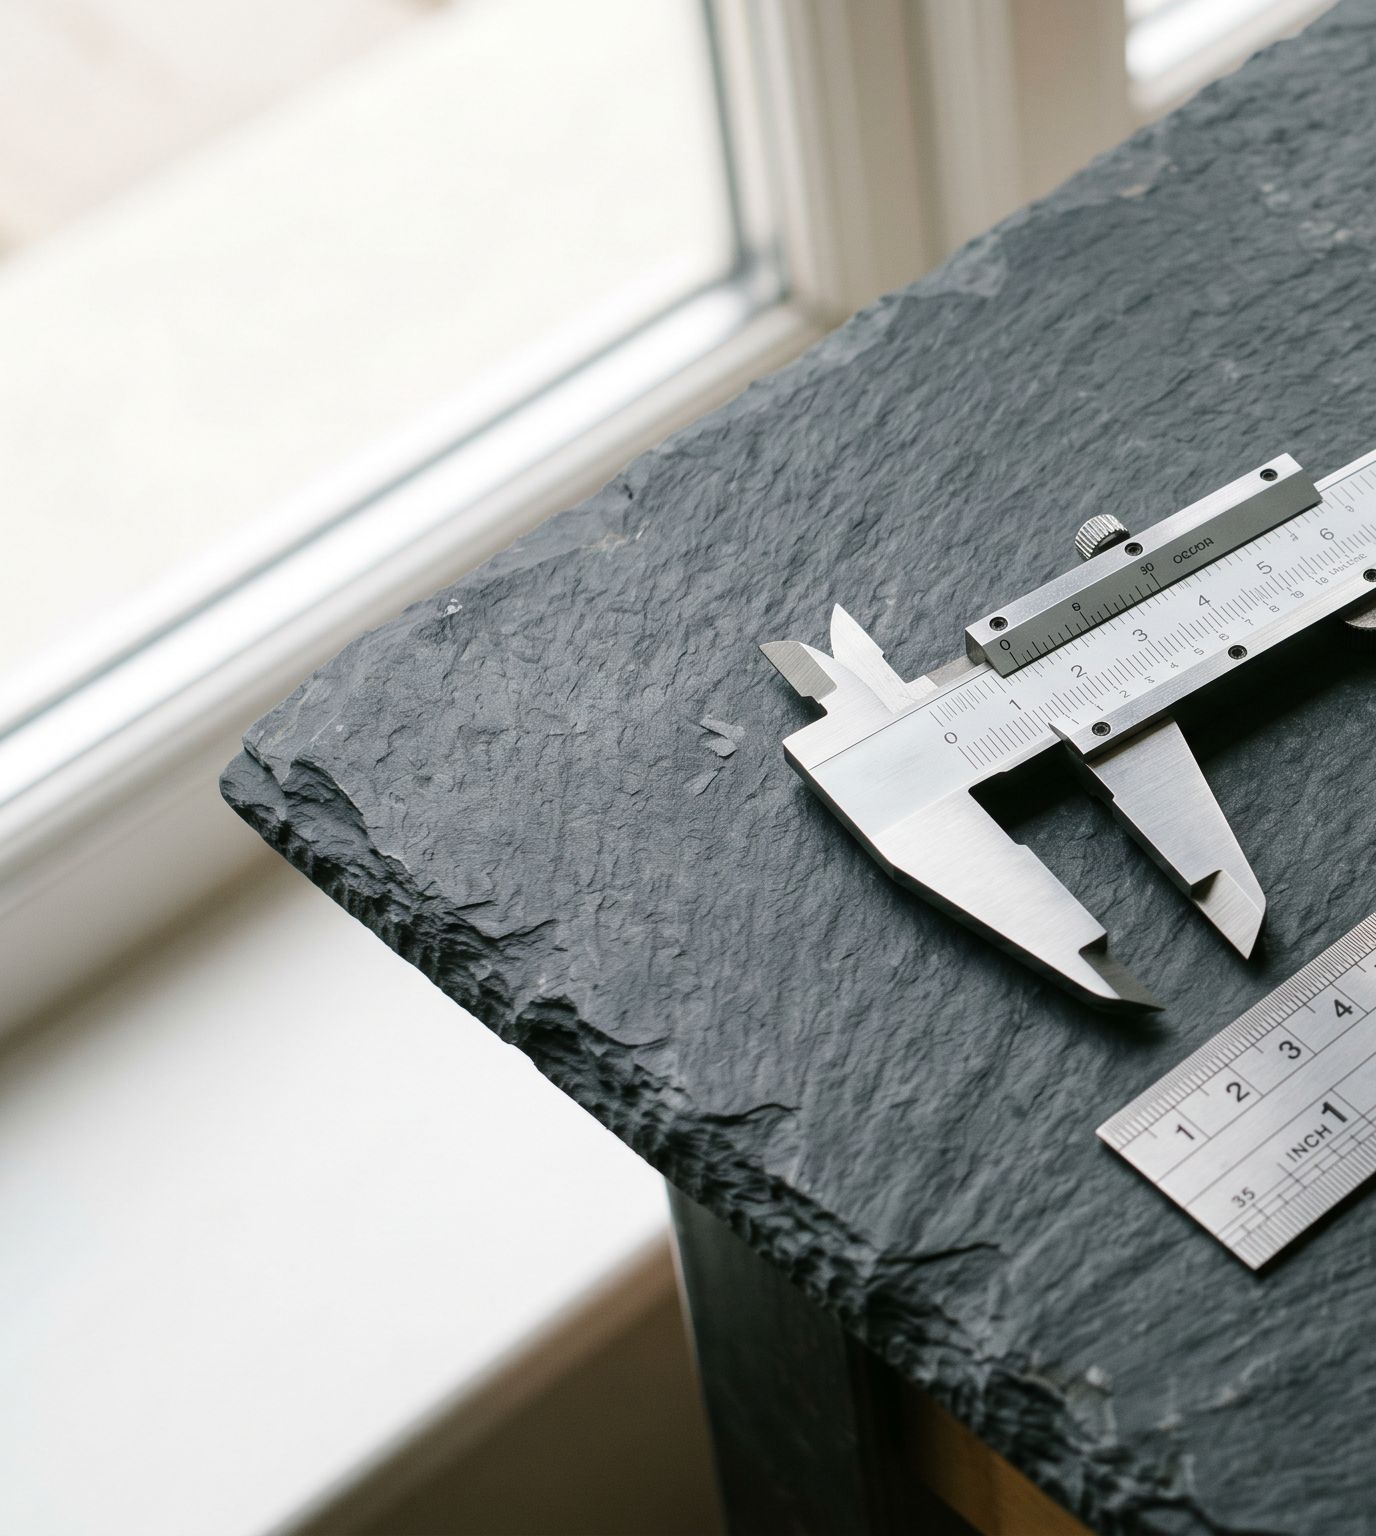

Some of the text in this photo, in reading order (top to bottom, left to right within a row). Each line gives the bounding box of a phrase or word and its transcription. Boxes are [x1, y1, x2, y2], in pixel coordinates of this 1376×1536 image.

[944, 731, 958, 744] 0
[1009, 699, 1021, 710] 1
[1070, 664, 1087, 678] 2
[1132, 629, 1148, 642] 3
[1198, 594, 1211, 606] 4
[1256, 561, 1272, 575] 5
[1319, 528, 1334, 540] 6
[1000, 639, 1011, 651] 0
[1174, 1122, 1196, 1142] 1
[1226, 1082, 1250, 1102] 2
[1278, 1040, 1302, 1061] 3
[1330, 999, 1354, 1020] 4
[1286, 1124, 1333, 1162] INCH
[1321, 1101, 1348, 1123] 1
